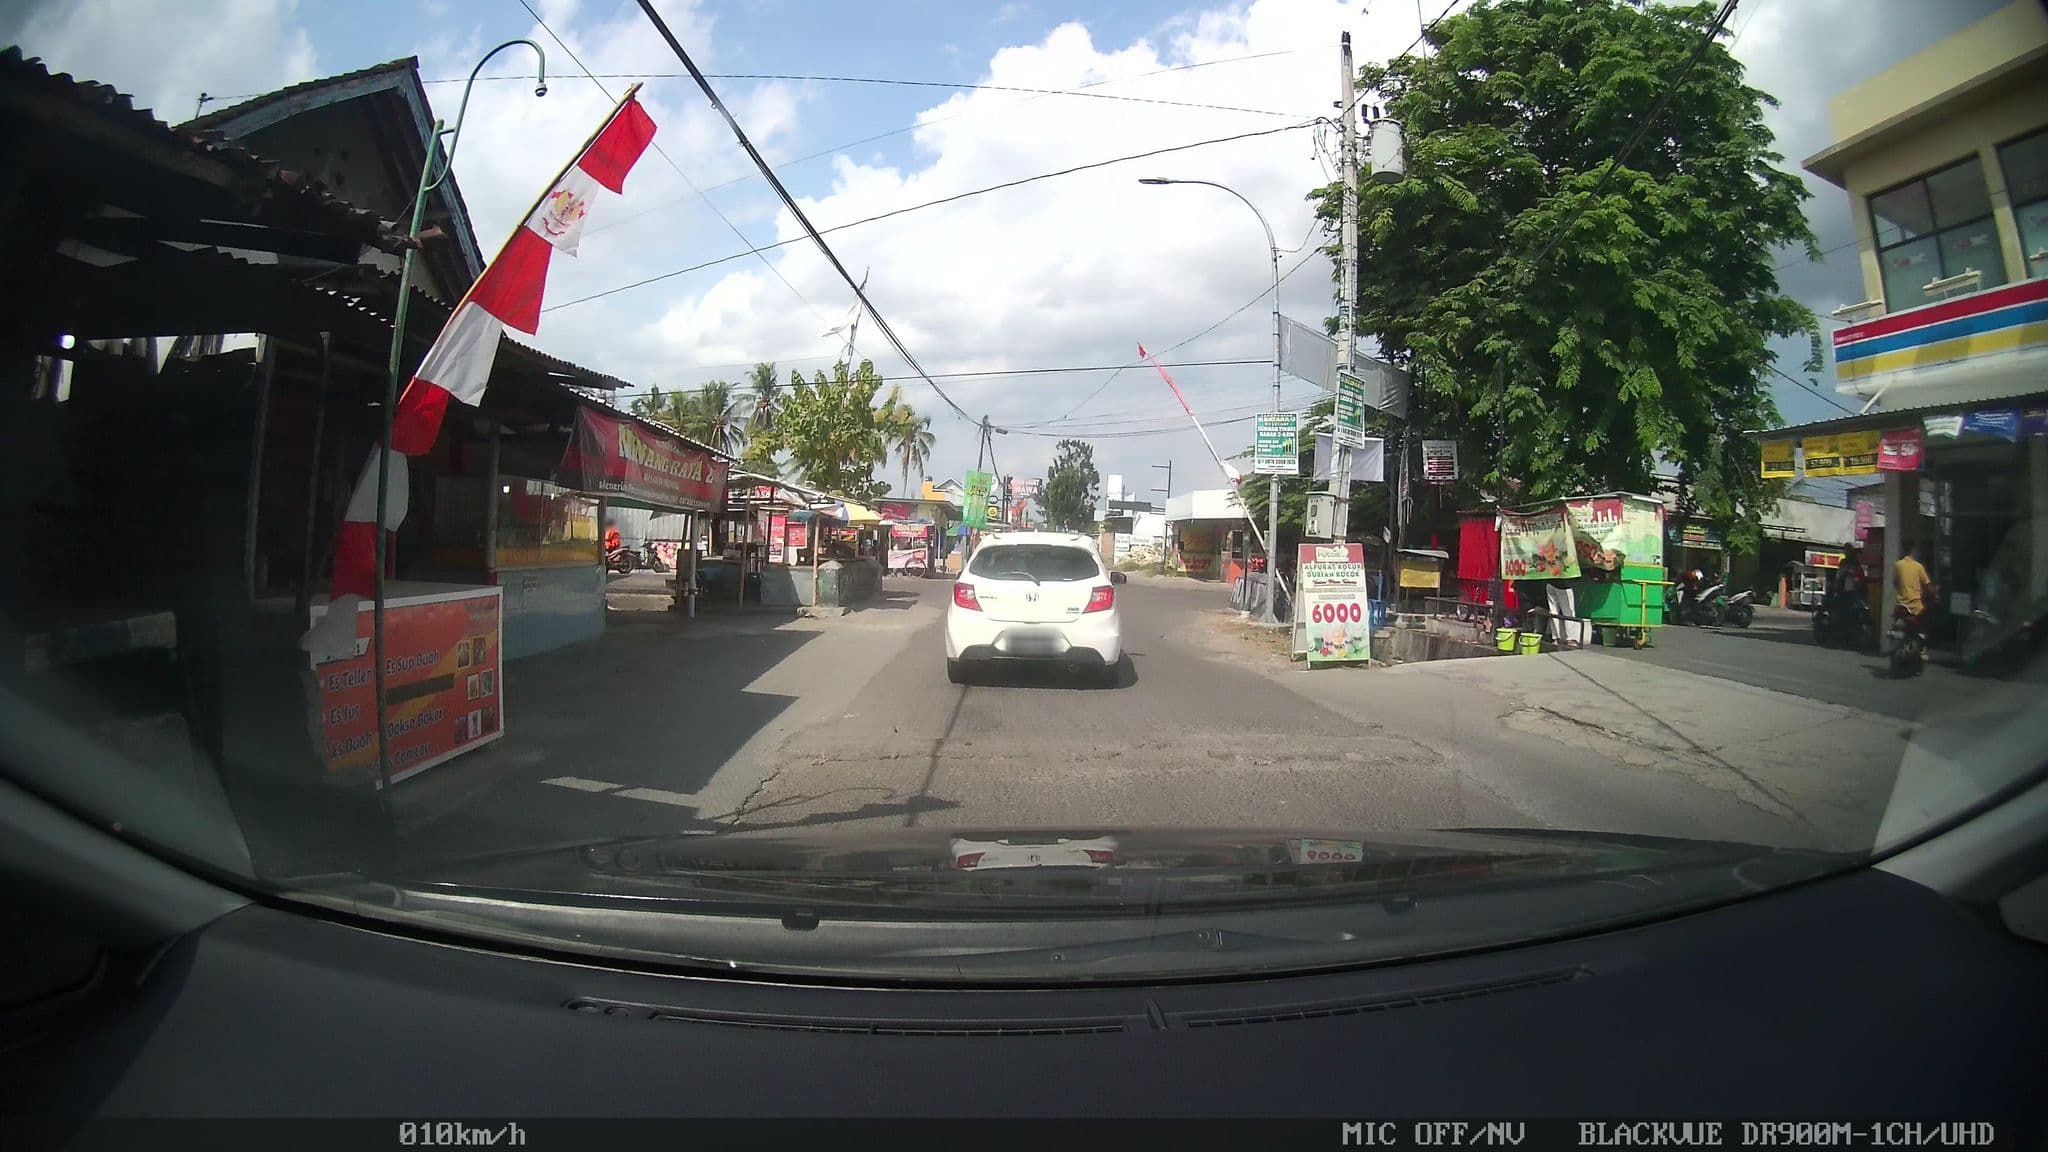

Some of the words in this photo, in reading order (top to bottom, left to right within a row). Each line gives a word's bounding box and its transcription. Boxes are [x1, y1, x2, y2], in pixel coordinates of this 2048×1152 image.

[1312, 603, 1361, 623] 6000
[386, 659, 396, 674] Es
[397, 656, 415, 673] Sup
[416, 650, 440, 667] Buah
[328, 672, 341, 690] Es
[342, 669, 371, 687] Teller
[329, 708, 341, 725] Es
[387, 718, 416, 738] Bakso
